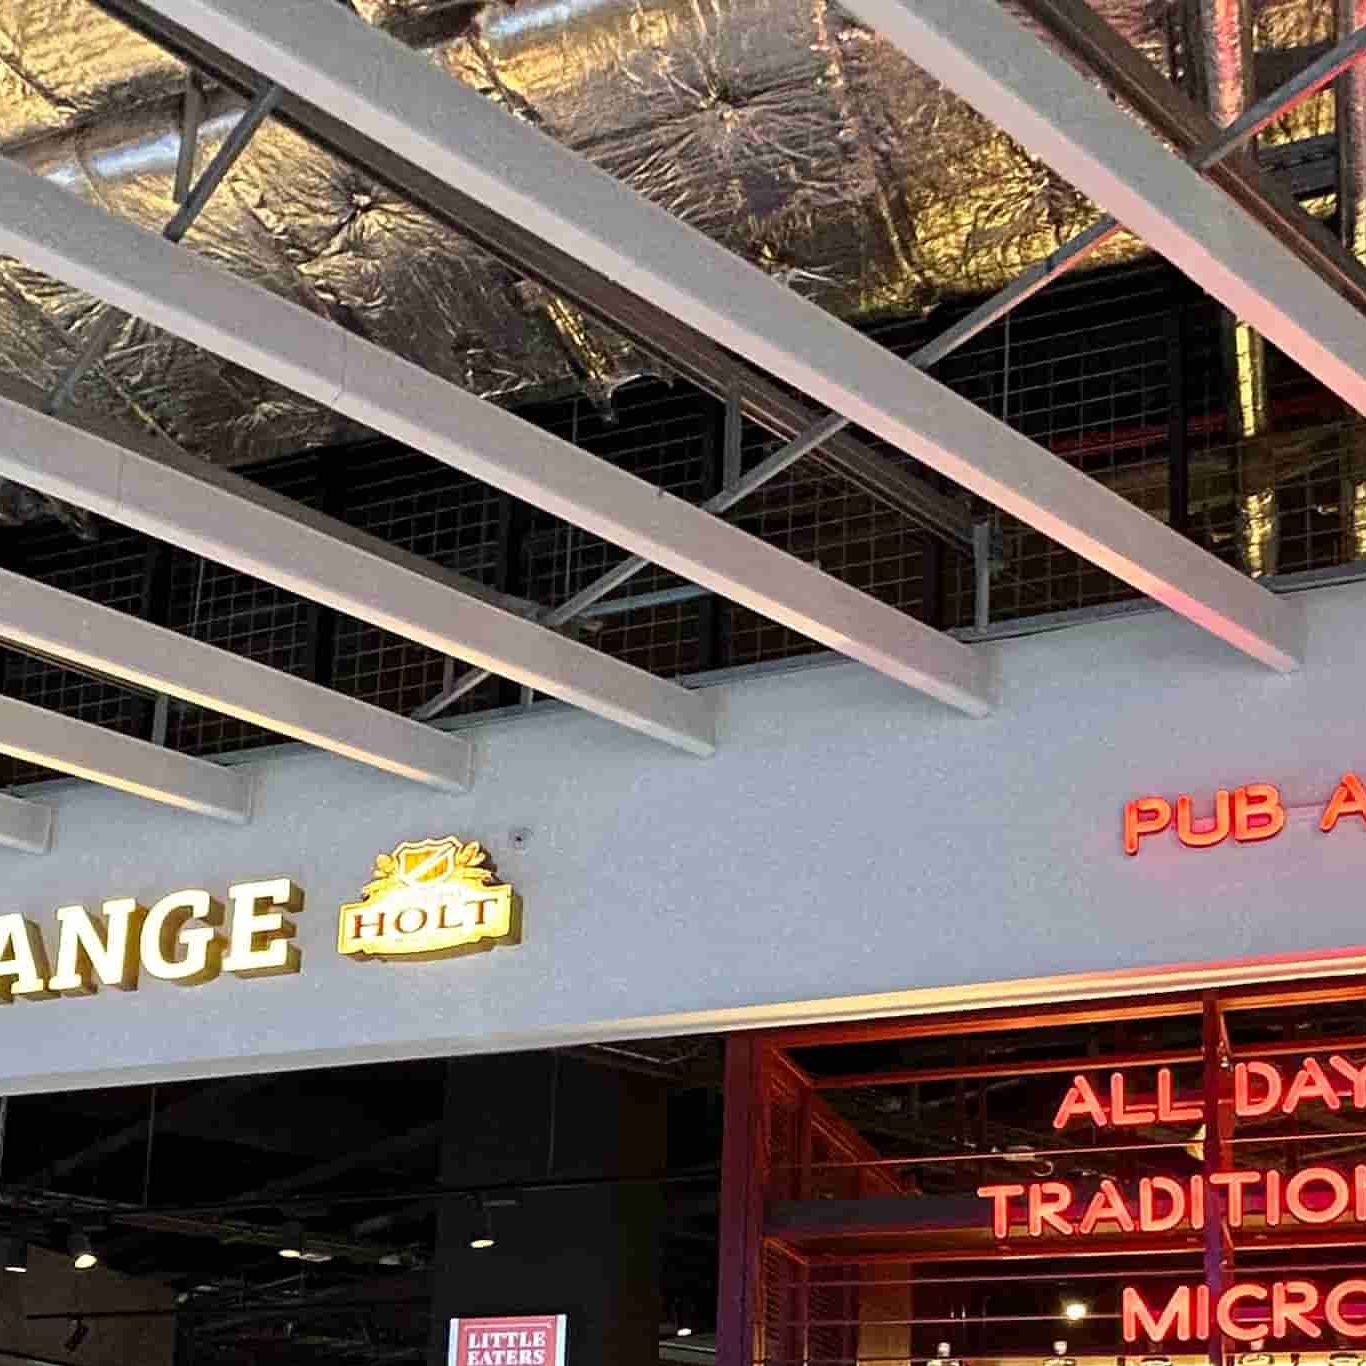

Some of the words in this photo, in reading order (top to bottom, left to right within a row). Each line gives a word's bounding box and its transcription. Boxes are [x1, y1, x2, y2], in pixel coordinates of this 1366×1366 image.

[1124, 785, 1286, 855] PUB
[350, 897, 499, 939] HOLT
[1052, 1068, 1203, 1130] ALL
[466, 1349, 546, 1366] EATERS
[467, 1331, 546, 1349] LITTLE
